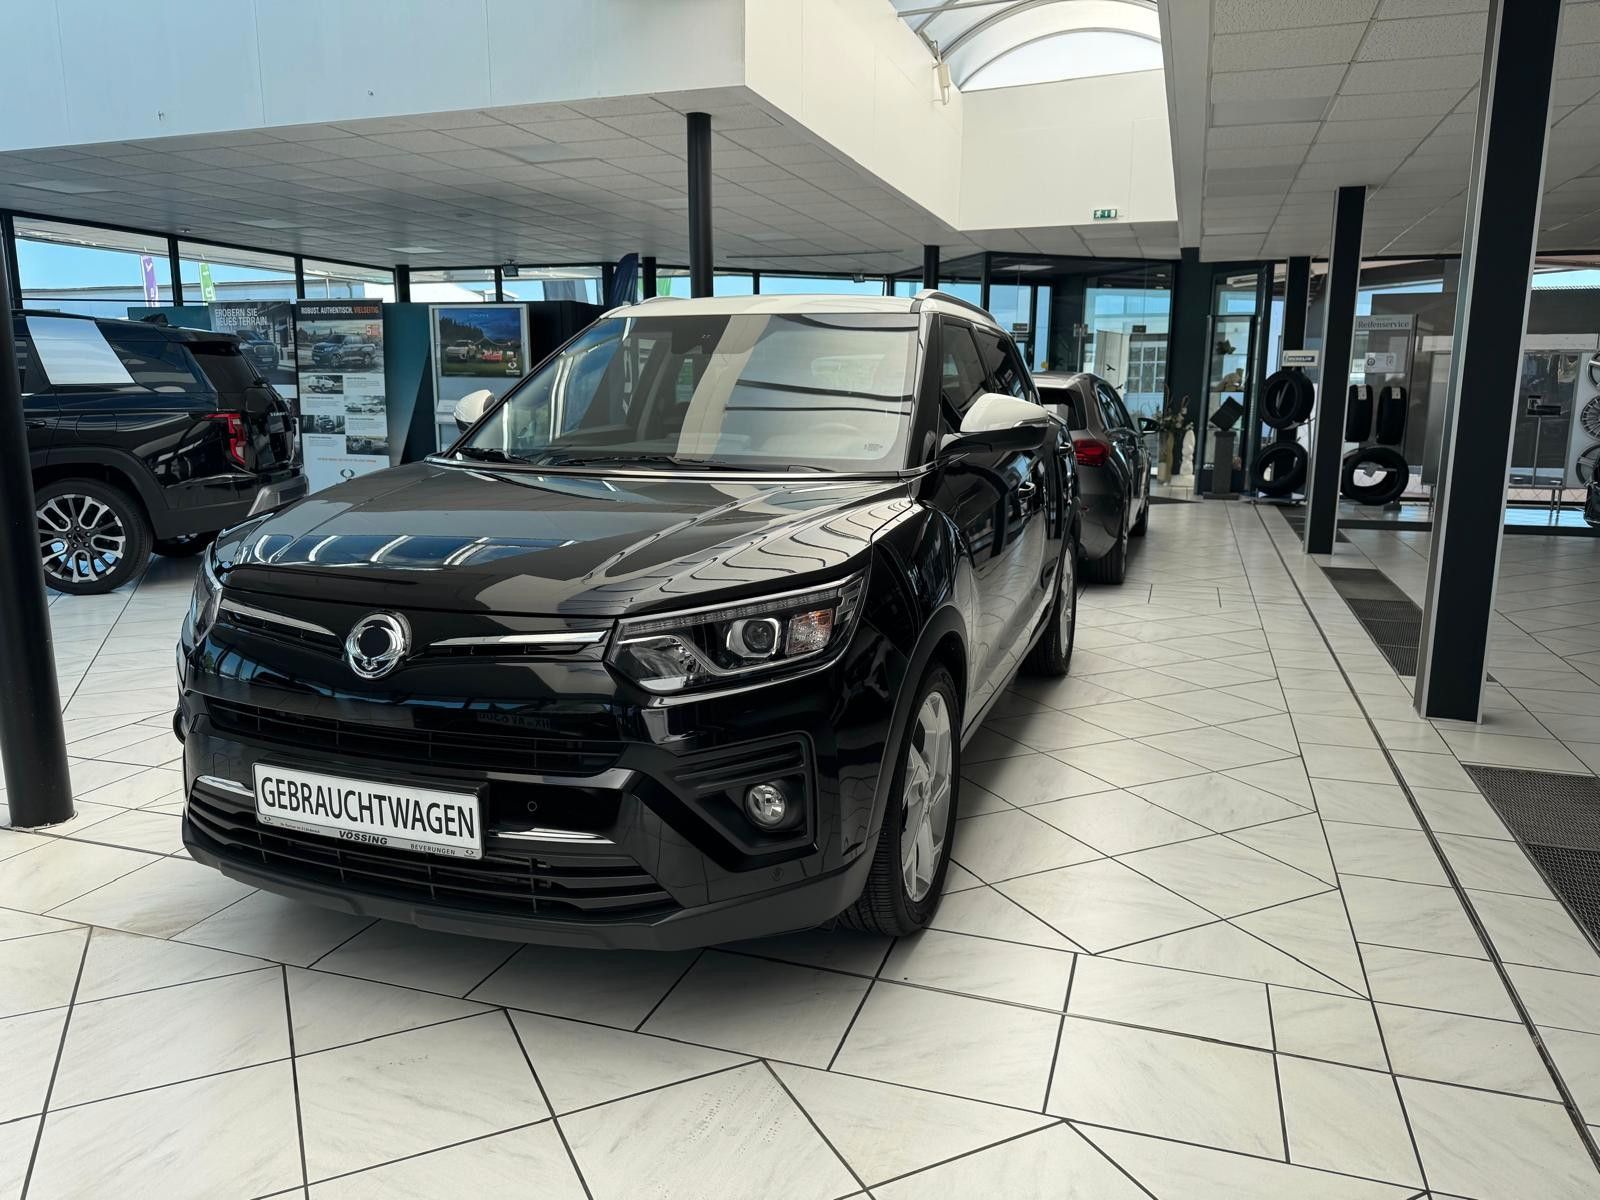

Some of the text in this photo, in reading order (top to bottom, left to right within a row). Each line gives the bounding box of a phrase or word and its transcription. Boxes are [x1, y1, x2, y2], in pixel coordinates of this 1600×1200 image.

[246, 308, 258, 317] SIE
[261, 776, 475, 839] GEBRAUCHTWAGEN
[339, 830, 388, 845] VÖSSING
[410, 844, 456, 855] BEVERUNGEN
